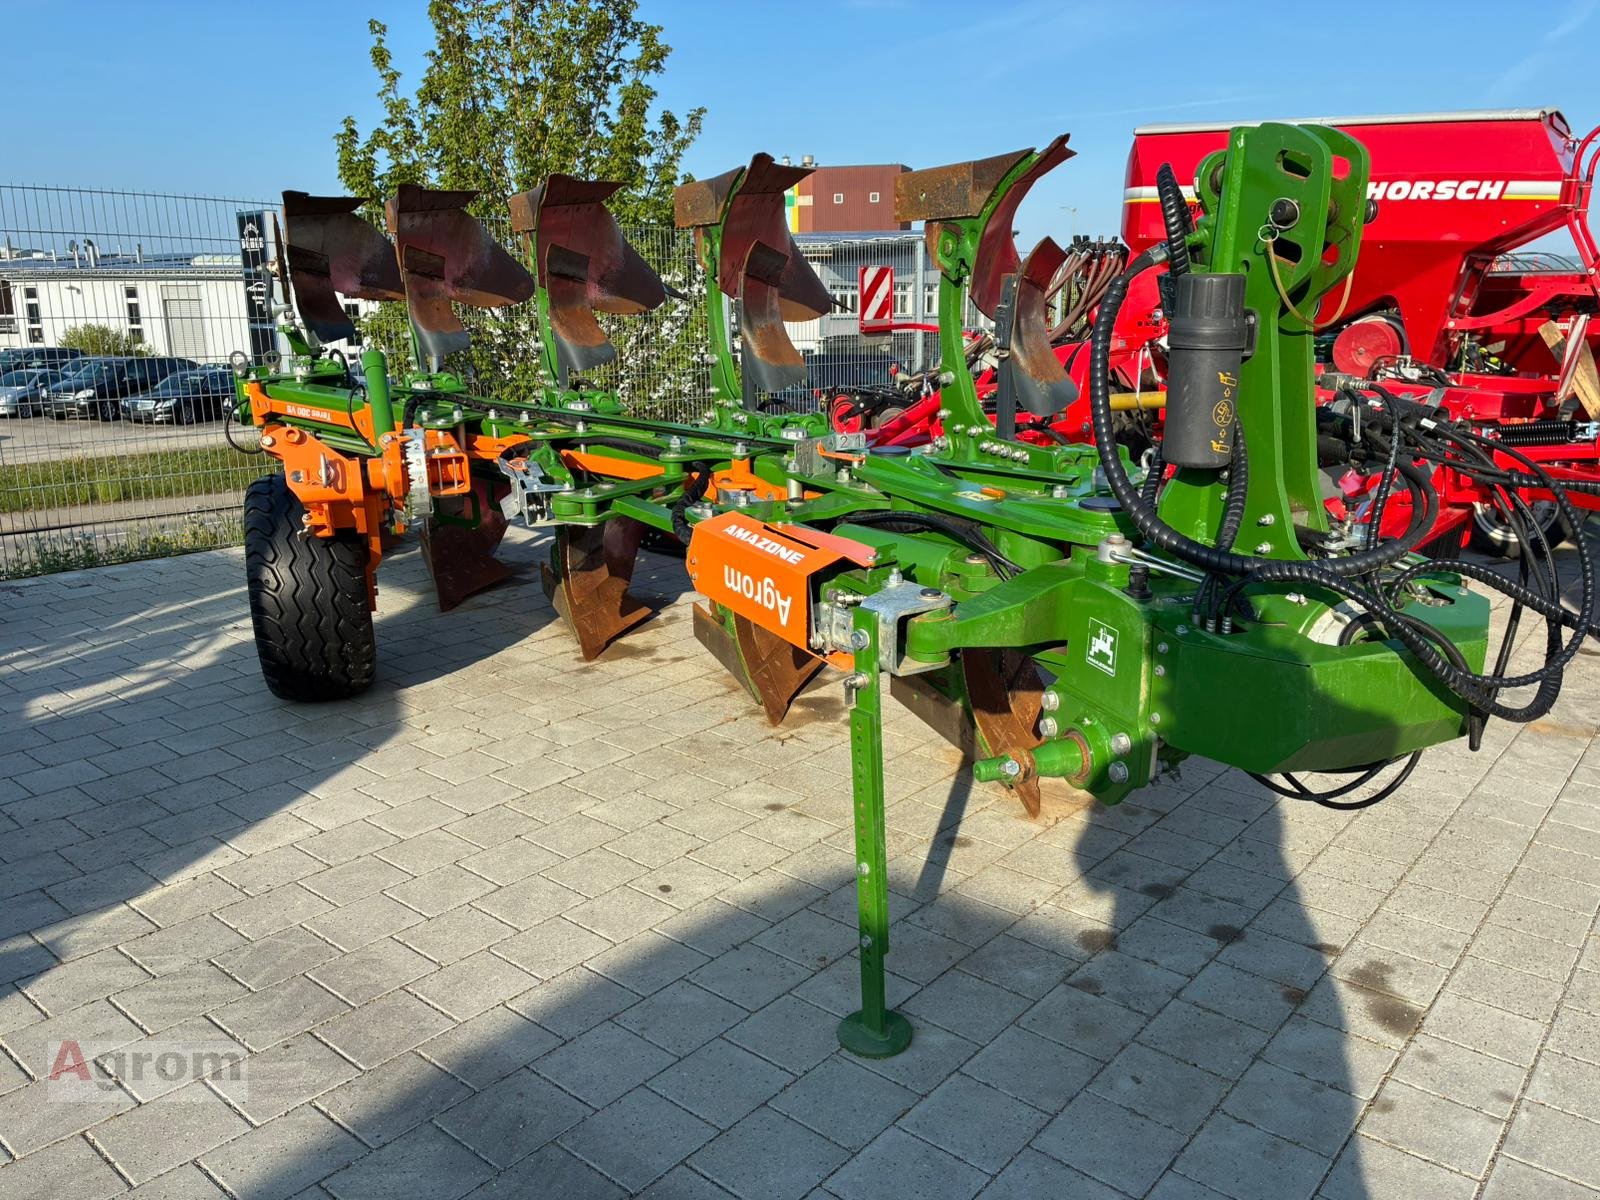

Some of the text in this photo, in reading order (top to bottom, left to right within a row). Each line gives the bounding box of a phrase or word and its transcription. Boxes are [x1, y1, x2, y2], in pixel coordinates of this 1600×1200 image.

[1367, 180, 1505, 200] HORSCH
[297, 407, 311, 417] 300
[841, 435, 848, 448] 2
[855, 434, 861, 447] 1
[722, 524, 805, 565] AMAZONE
[724, 564, 792, 627] Agrom
